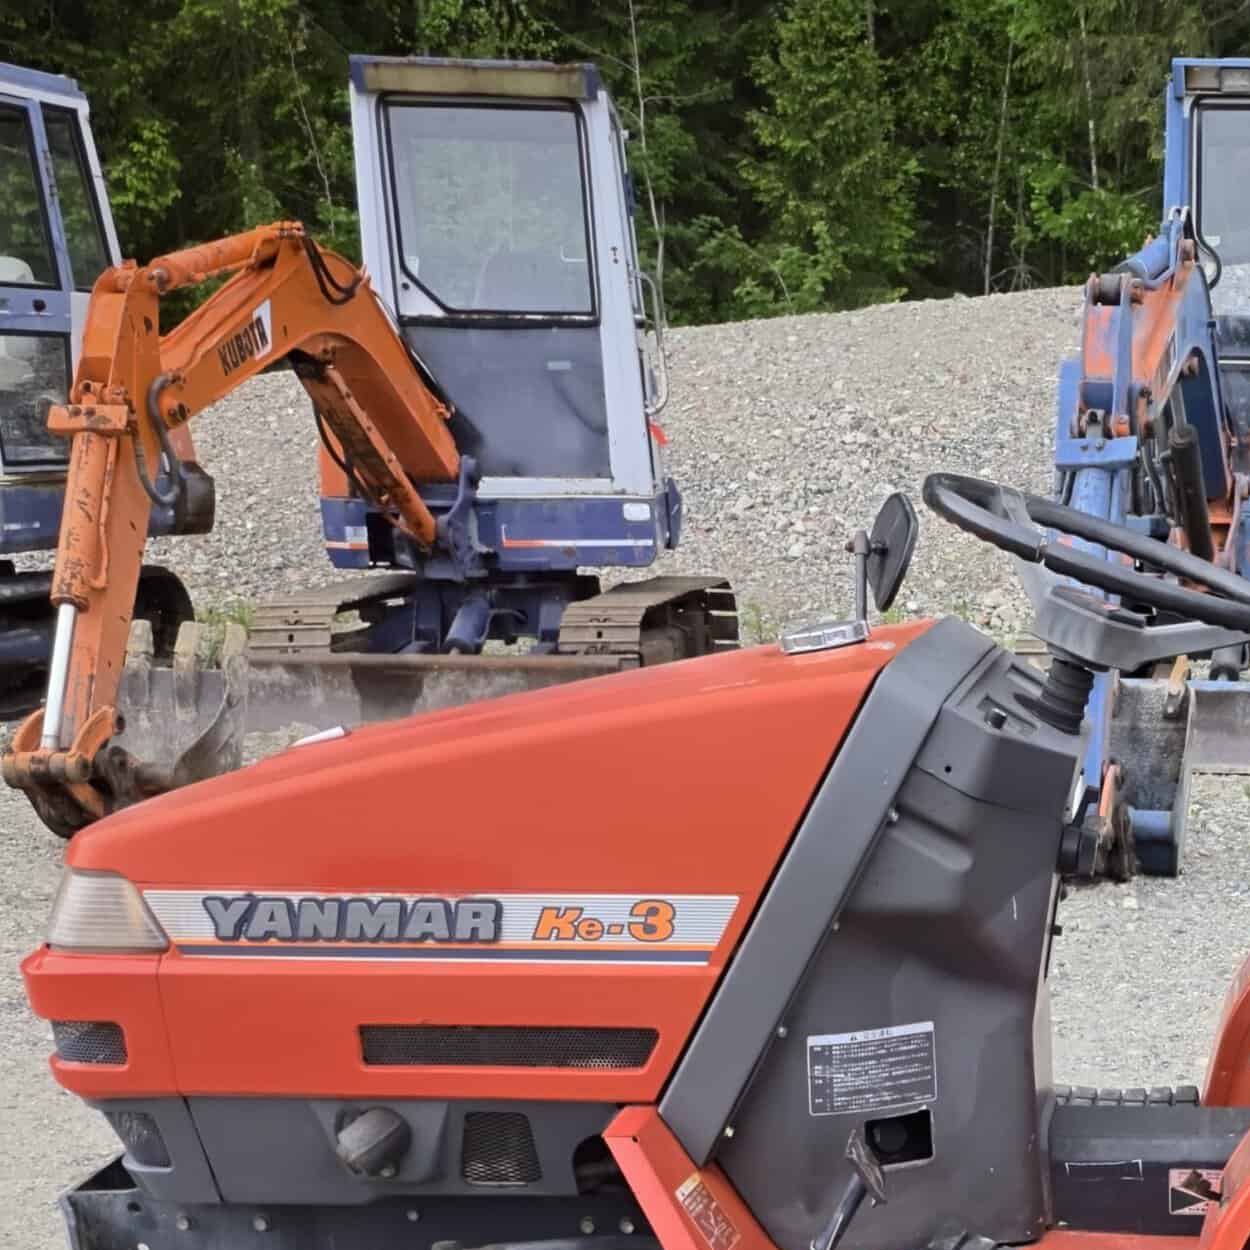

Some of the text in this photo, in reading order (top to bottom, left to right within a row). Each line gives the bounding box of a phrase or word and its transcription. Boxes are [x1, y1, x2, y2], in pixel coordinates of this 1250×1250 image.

[217, 316, 268, 377] KUBOTA
[202, 896, 678, 944] YANMAR Ke-3
